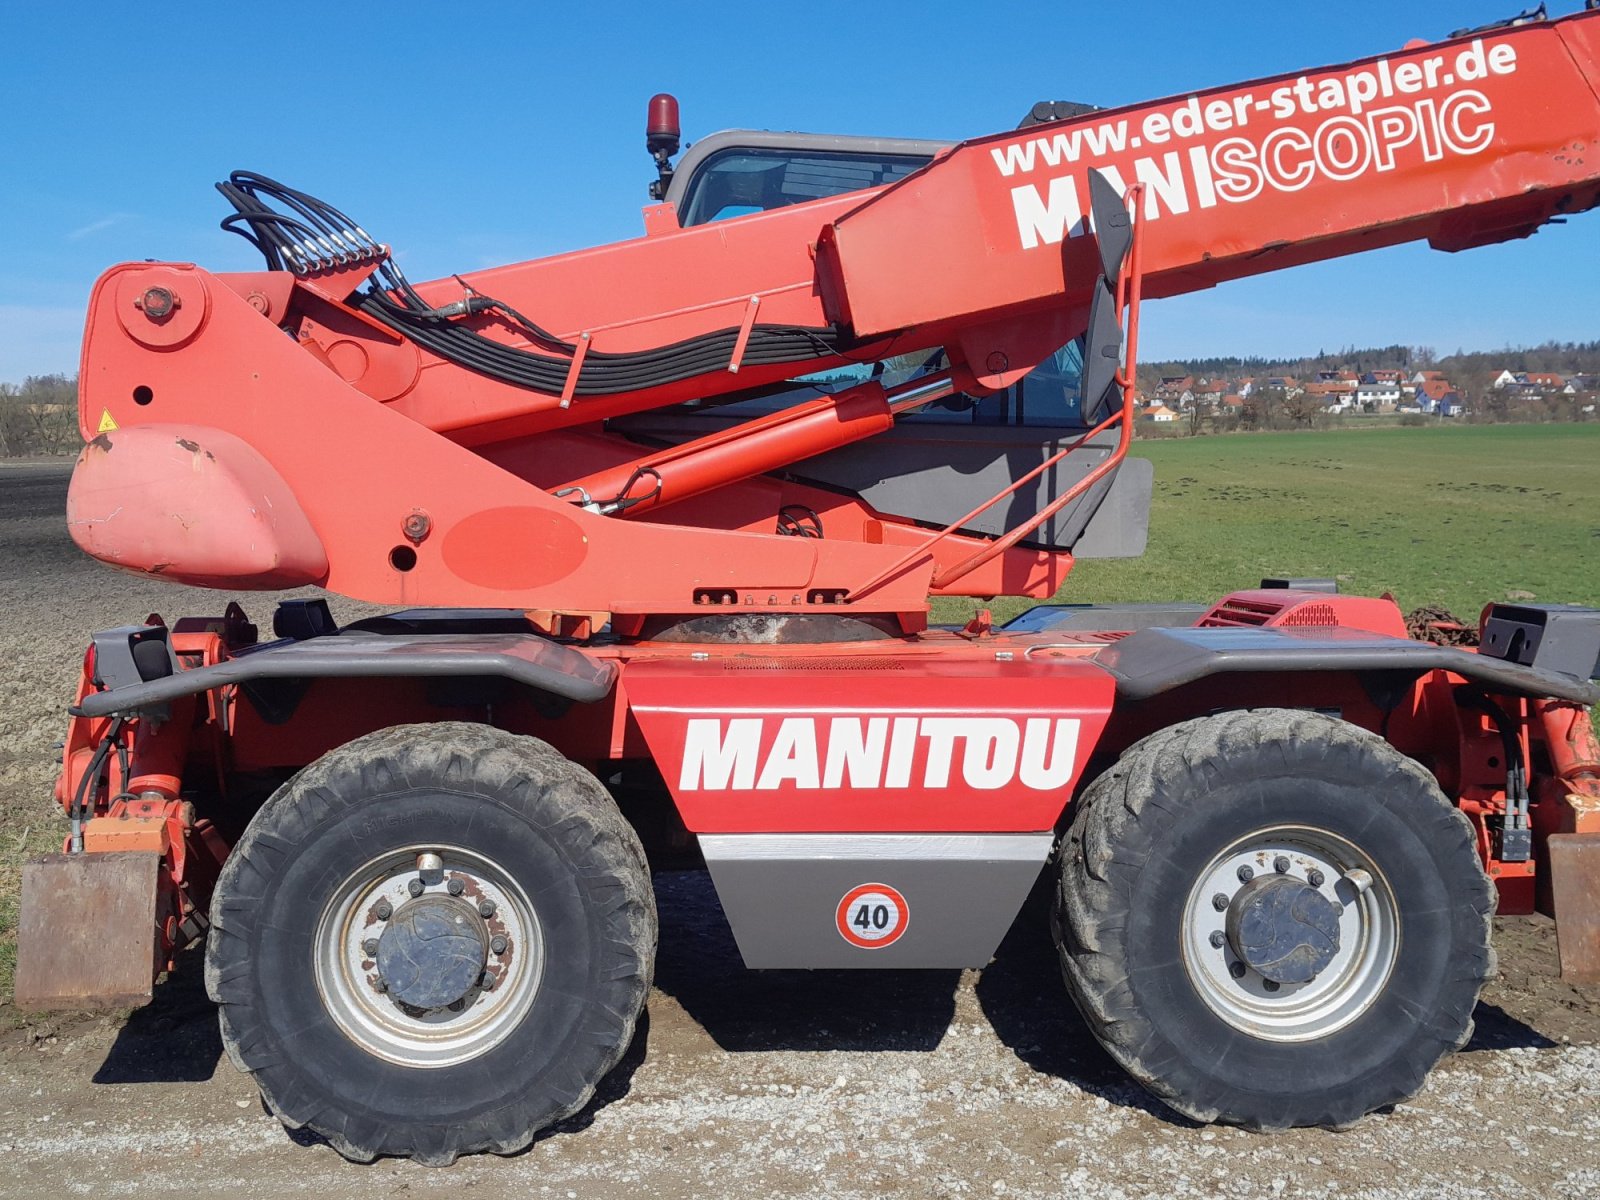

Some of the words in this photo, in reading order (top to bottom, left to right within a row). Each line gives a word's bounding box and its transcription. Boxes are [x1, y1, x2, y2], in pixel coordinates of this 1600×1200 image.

[990, 38, 1517, 177] www.eder-stapler.de
[679, 717, 1081, 790] MANITOU
[853, 904, 889, 930] 40
